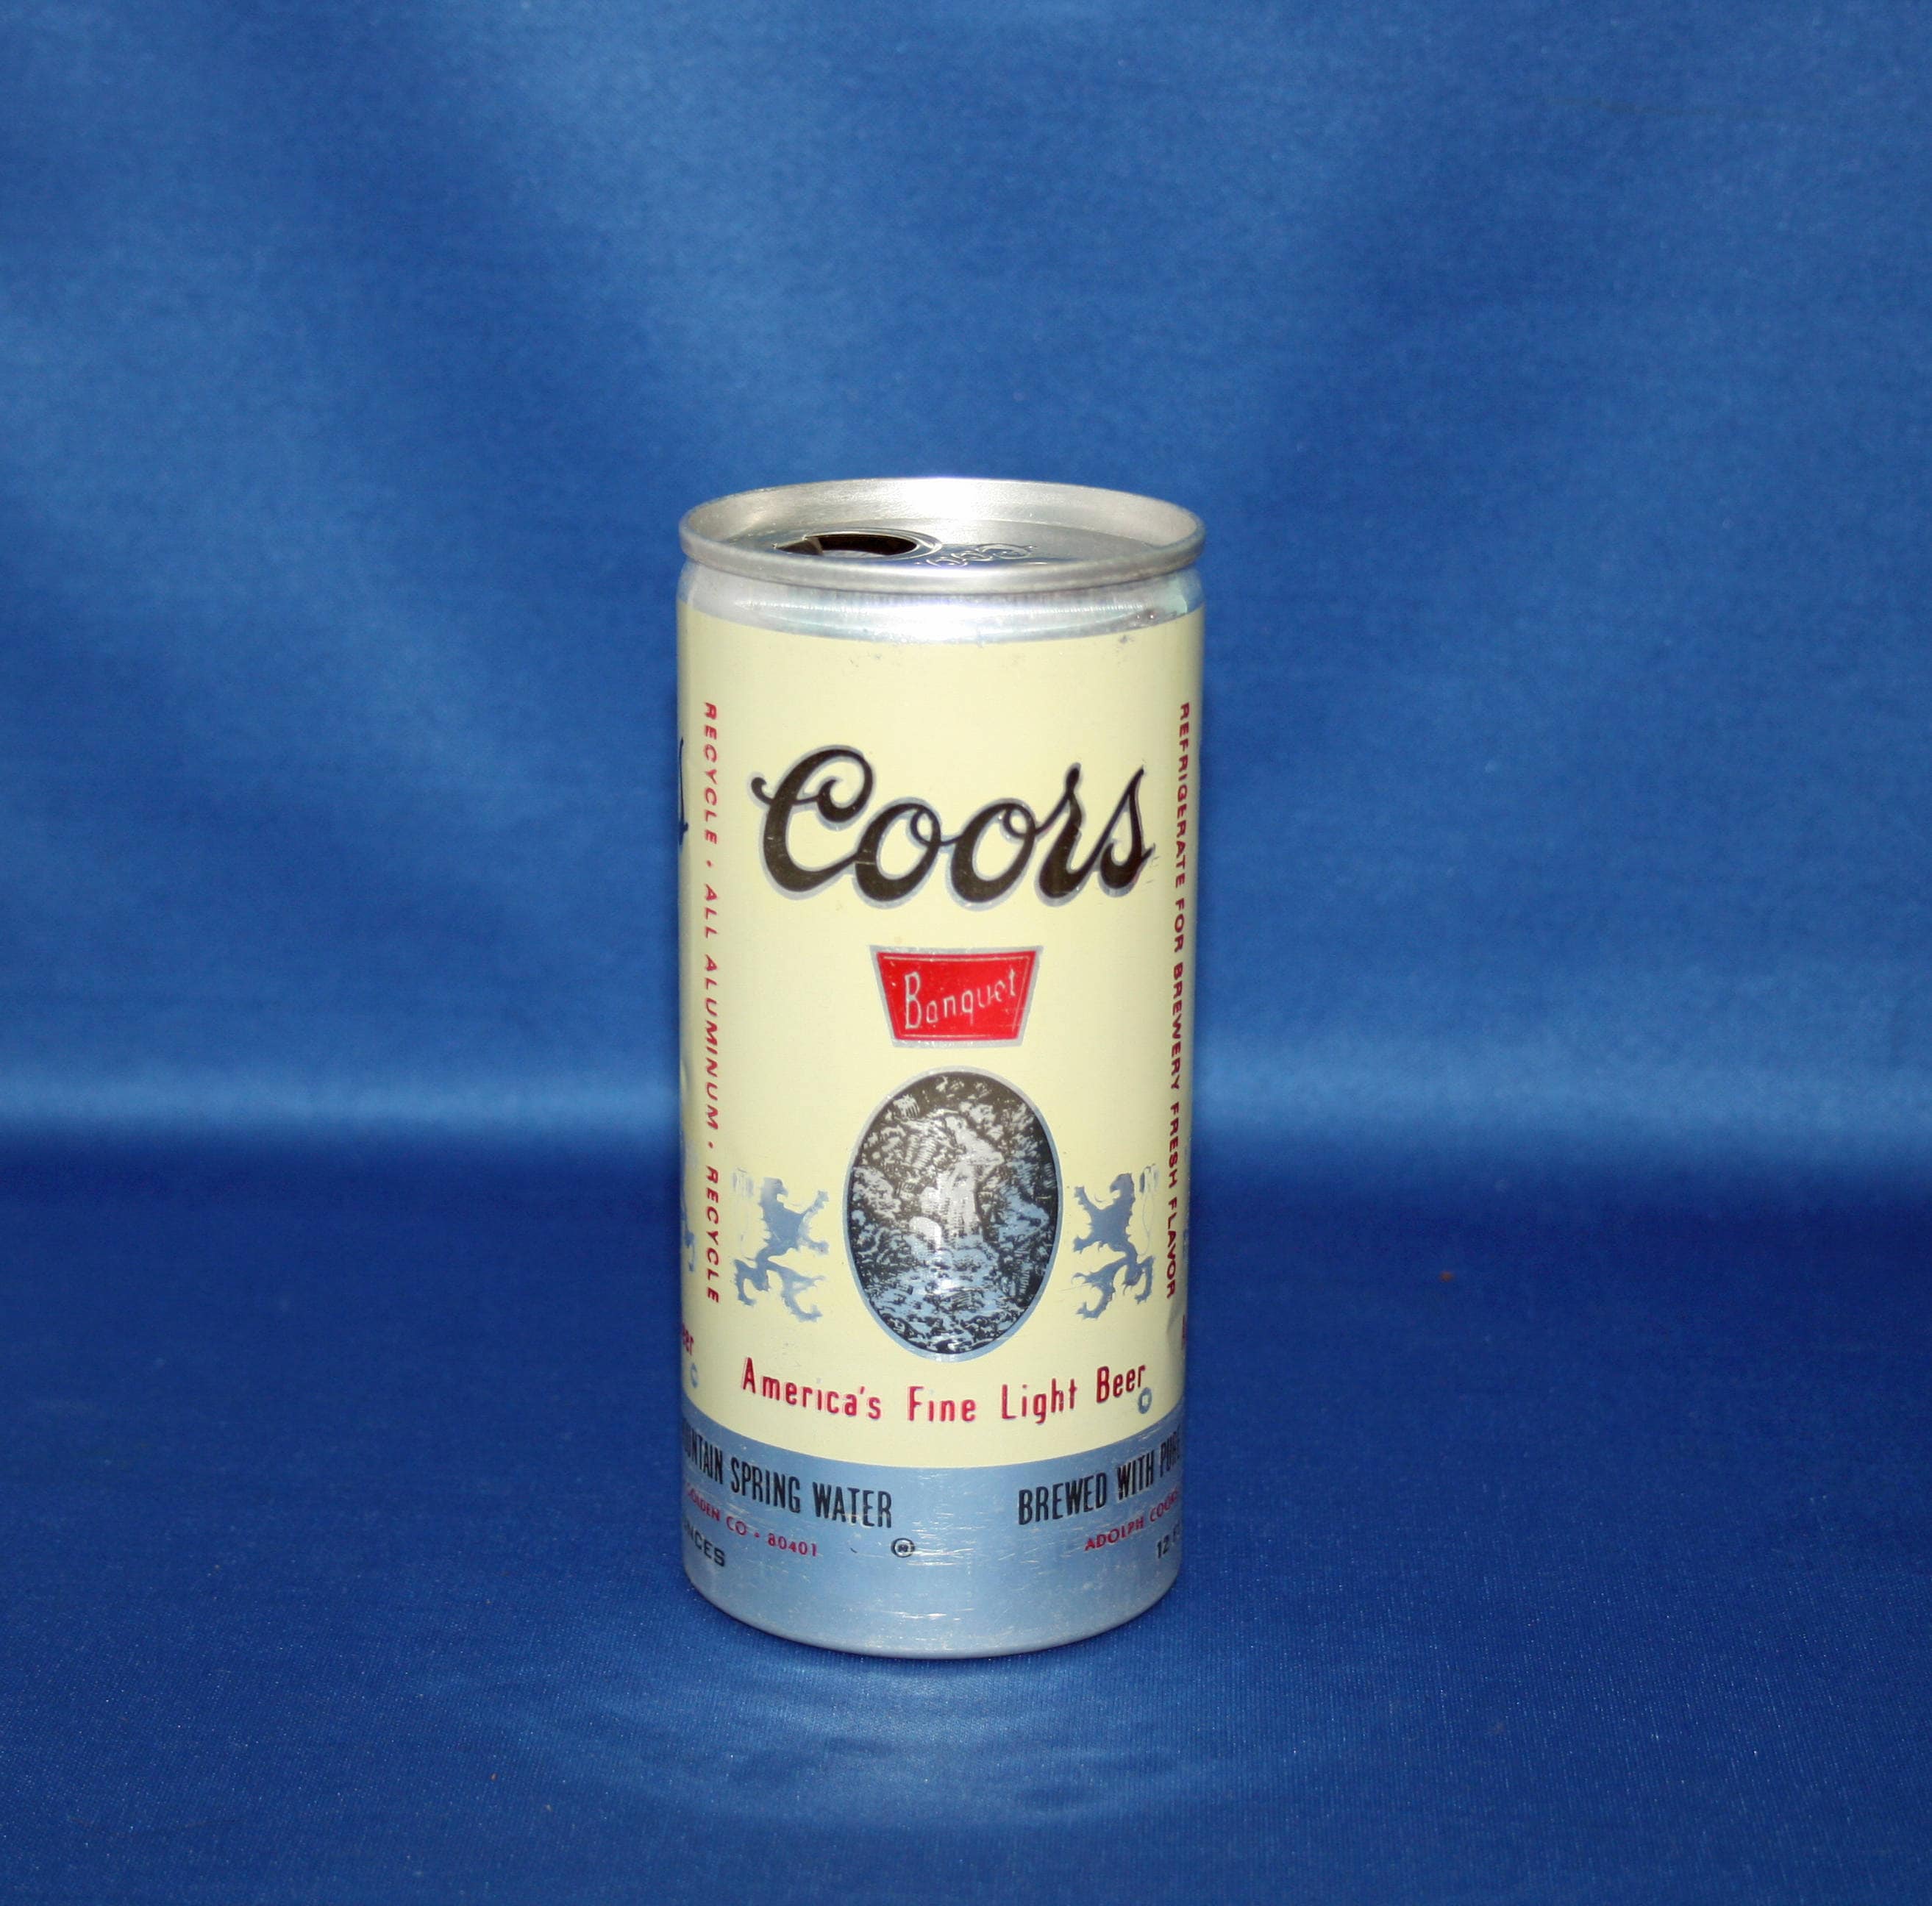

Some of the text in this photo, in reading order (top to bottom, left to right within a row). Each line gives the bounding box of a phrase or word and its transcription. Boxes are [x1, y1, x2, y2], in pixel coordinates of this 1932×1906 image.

[748, 746, 1155, 910] Coors
[704, 702, 720, 1303] RECYCLE ALL ALUMINUM RECYCLE
[905, 968, 1016, 1029] Banquet
[1166, 702, 1190, 1299] REFRIGERATE FOR BREWERY FRESH FLAVOR
[741, 1357, 1147, 1424] America's Fine Light Beer
[730, 1457, 802, 1513] SPRING
[812, 1481, 892, 1529] WATER
[1018, 1471, 1108, 1526] BREWED
[1117, 1450, 1155, 1501] WITH
[725, 1516, 748, 1536] CO
[767, 1532, 818, 1557] 80401
[1084, 1516, 1145, 1552] ADOLPH
[1156, 1534, 1170, 1560] 12
